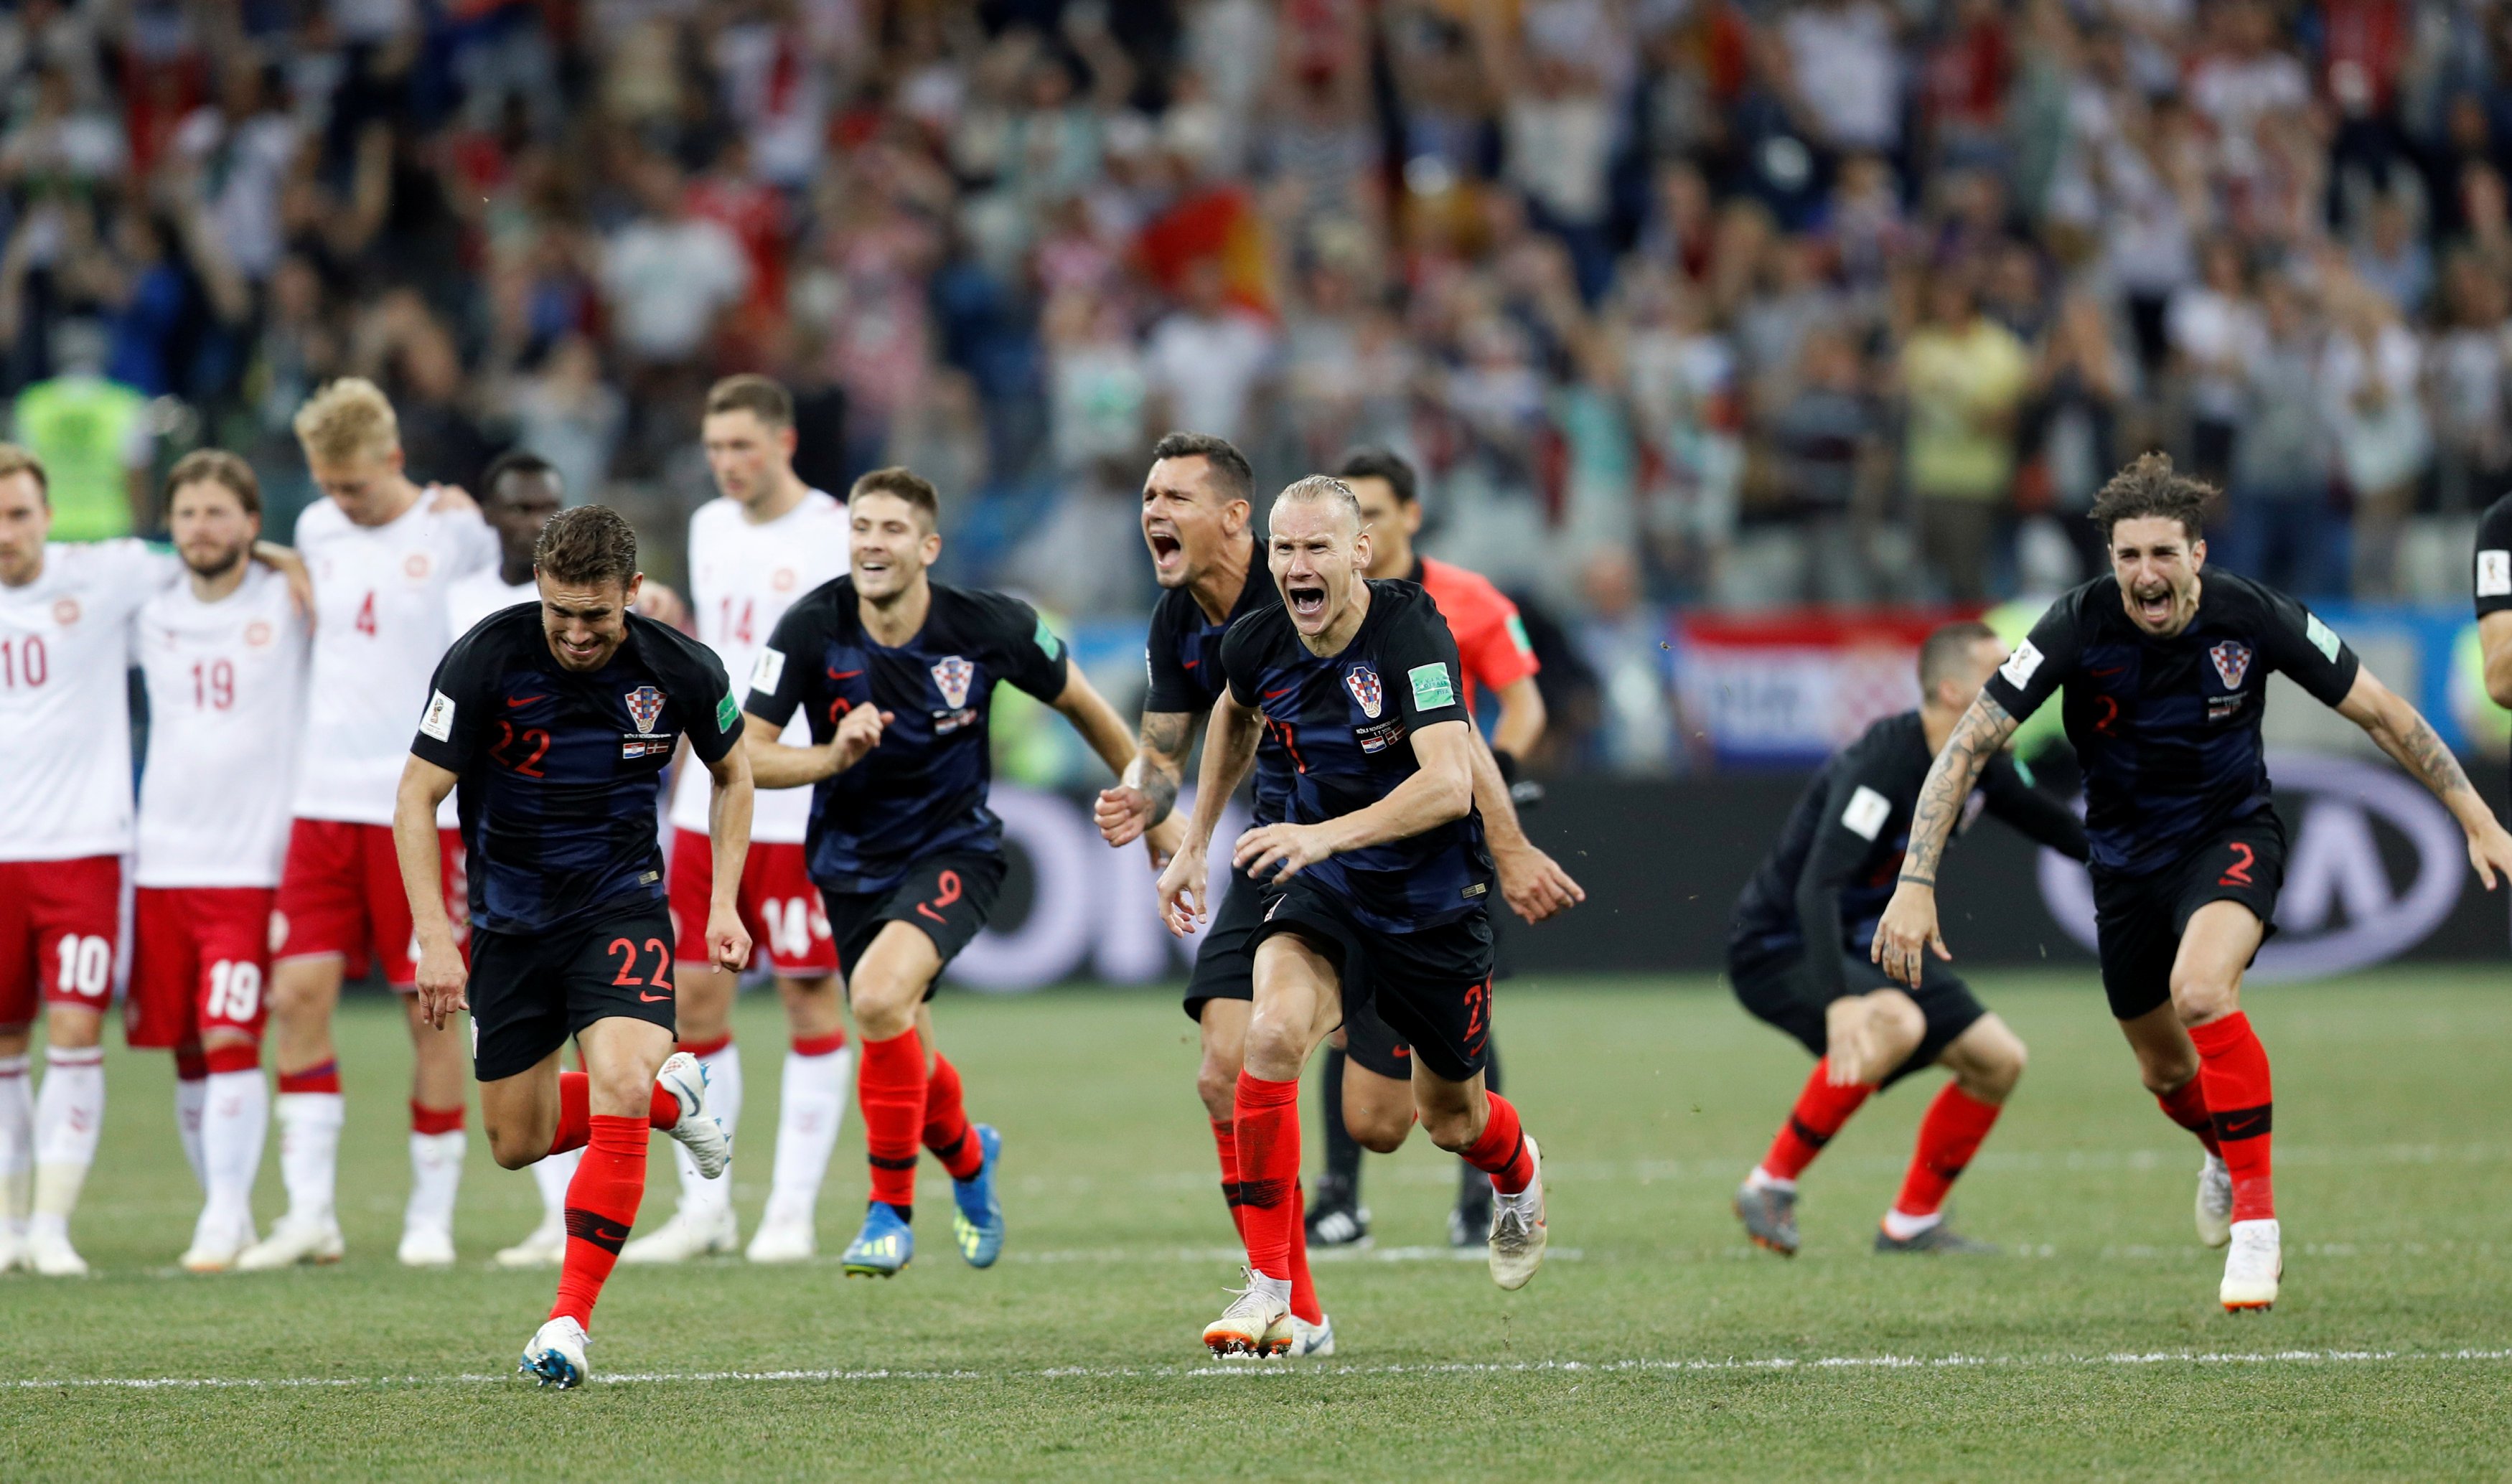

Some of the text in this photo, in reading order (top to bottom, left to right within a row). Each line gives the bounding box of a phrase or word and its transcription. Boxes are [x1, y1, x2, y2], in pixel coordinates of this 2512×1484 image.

[356, 591, 377, 637] 4
[718, 596, 753, 644] 14
[2, 634, 47, 688] 10
[191, 659, 235, 709] 19
[2093, 695, 2118, 738] 2
[489, 720, 550, 778] 22
[2225, 842, 2255, 883] 2
[934, 869, 962, 908] 9
[762, 896, 810, 958] 14
[57, 933, 111, 997] 10
[608, 938, 672, 991] 22
[207, 960, 261, 1022] 19
